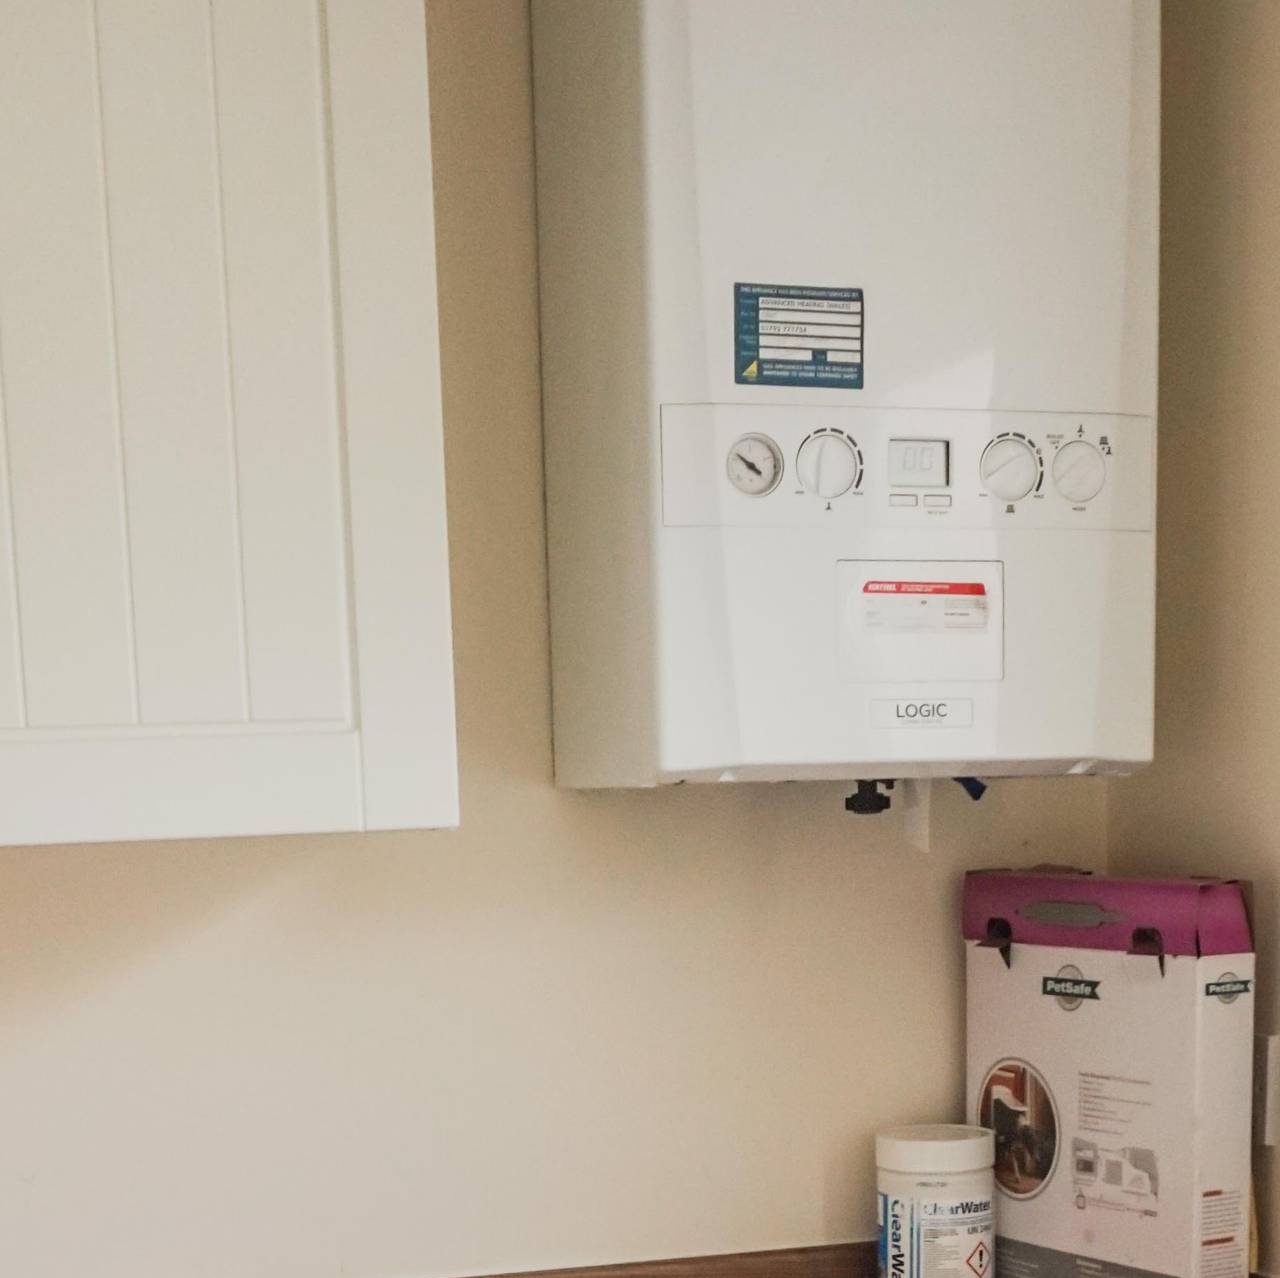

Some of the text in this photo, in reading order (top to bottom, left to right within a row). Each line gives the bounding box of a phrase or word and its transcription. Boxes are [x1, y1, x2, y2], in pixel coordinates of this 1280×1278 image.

[896, 703, 948, 718] LOGIC
[1046, 980, 1092, 996] PetSafe
[924, 1201, 991, 1216] larWater
